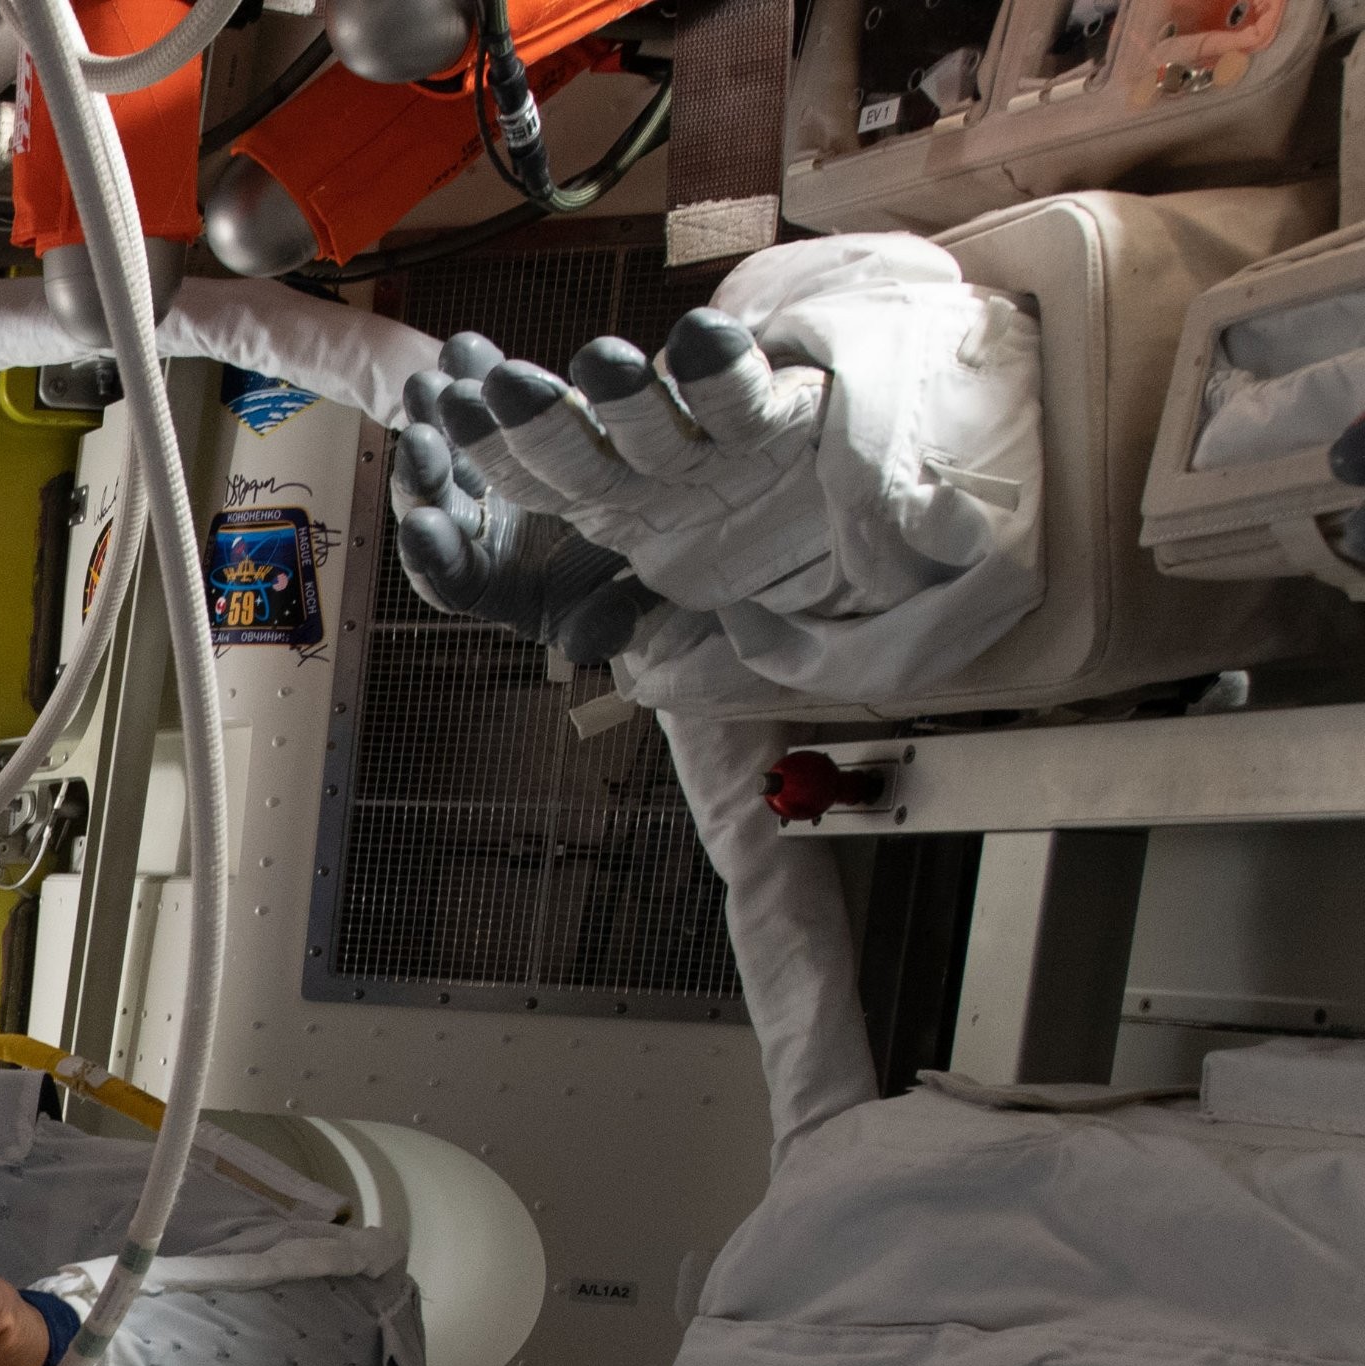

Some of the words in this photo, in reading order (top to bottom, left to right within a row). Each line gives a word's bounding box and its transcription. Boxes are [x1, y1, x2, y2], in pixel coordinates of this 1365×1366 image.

[866, 107, 881, 125] EV
[885, 106, 889, 118] 1
[227, 510, 281, 522] КОНОНЕНКО
[298, 527, 311, 566] HAGUE
[305, 582, 317, 614] KOCH
[228, 591, 255, 626] 59
[577, 1284, 629, 1298] A/L1A2
